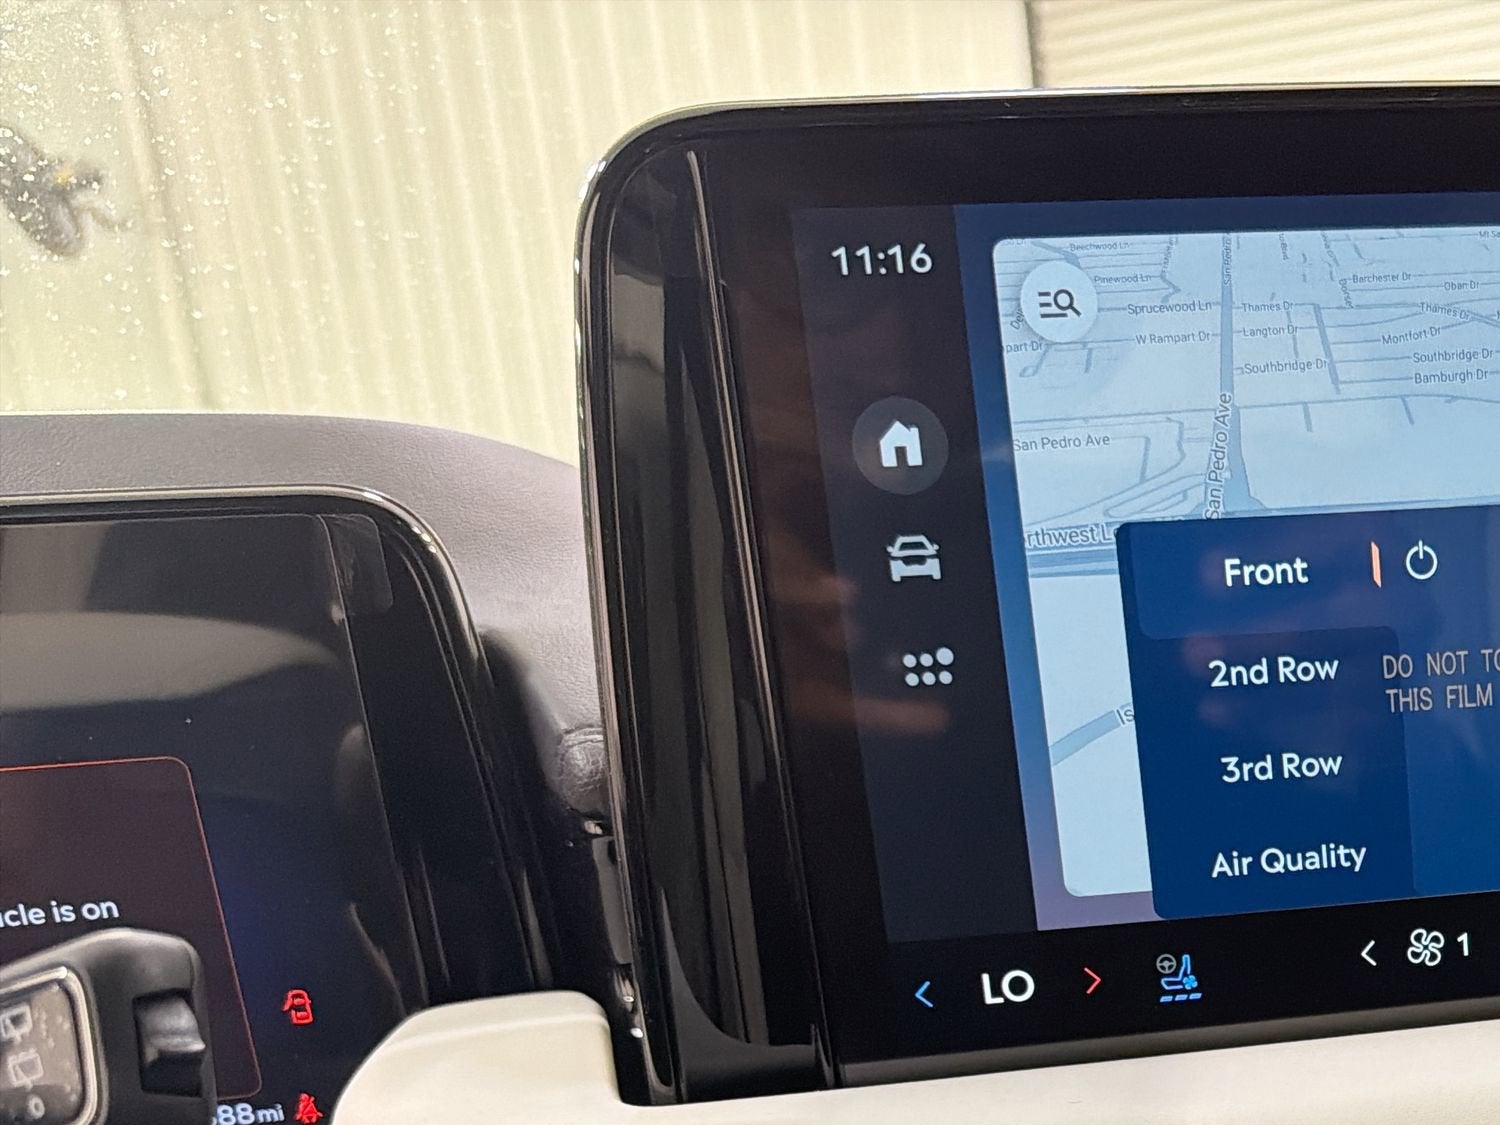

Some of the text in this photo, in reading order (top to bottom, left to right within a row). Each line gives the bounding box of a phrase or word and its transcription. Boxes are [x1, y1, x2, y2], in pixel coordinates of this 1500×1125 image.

[832, 243, 932, 276] 11:16
[1094, 275, 1139, 284] Pinewood
[1351, 271, 1412, 284] Barchester Dr
[1443, 280, 1480, 291] Oban Dr
[1127, 301, 1212, 316] Sprucewood Ln
[1242, 301, 1294, 312] Thames Dr
[1420, 302, 1470, 321] Thames Dr
[1136, 332, 1210, 346] W Rampart Dr
[1243, 324, 1298, 340] Langton Dr
[1381, 325, 1441, 345] Montfort Dr
[1030, 341, 1043, 351] Dr
[1412, 347, 1494, 364] Southbridge Dr
[1244, 357, 1328, 375] Southbridge Dr
[1414, 368, 1488, 386] Bamburgh Dr
[1013, 433, 1110, 452] San Pedro Ave
[1204, 391, 1233, 520] San Pedro Ave
[1025, 523, 1096, 548] rthwest
[1224, 556, 1309, 587] Front
[1208, 656, 1339, 688] 2nd Row
[1382, 653, 1413, 680] DO
[1426, 650, 1468, 676] NOT
[1385, 686, 1433, 713] THIS
[1446, 682, 1493, 710] FILM
[1220, 752, 1343, 783] 3rd Row
[1211, 842, 1367, 878] Air Quality
[50, 900, 76, 923] is
[81, 900, 120, 921] on
[1457, 931, 1469, 957] 1
[981, 969, 1035, 1005] LO
